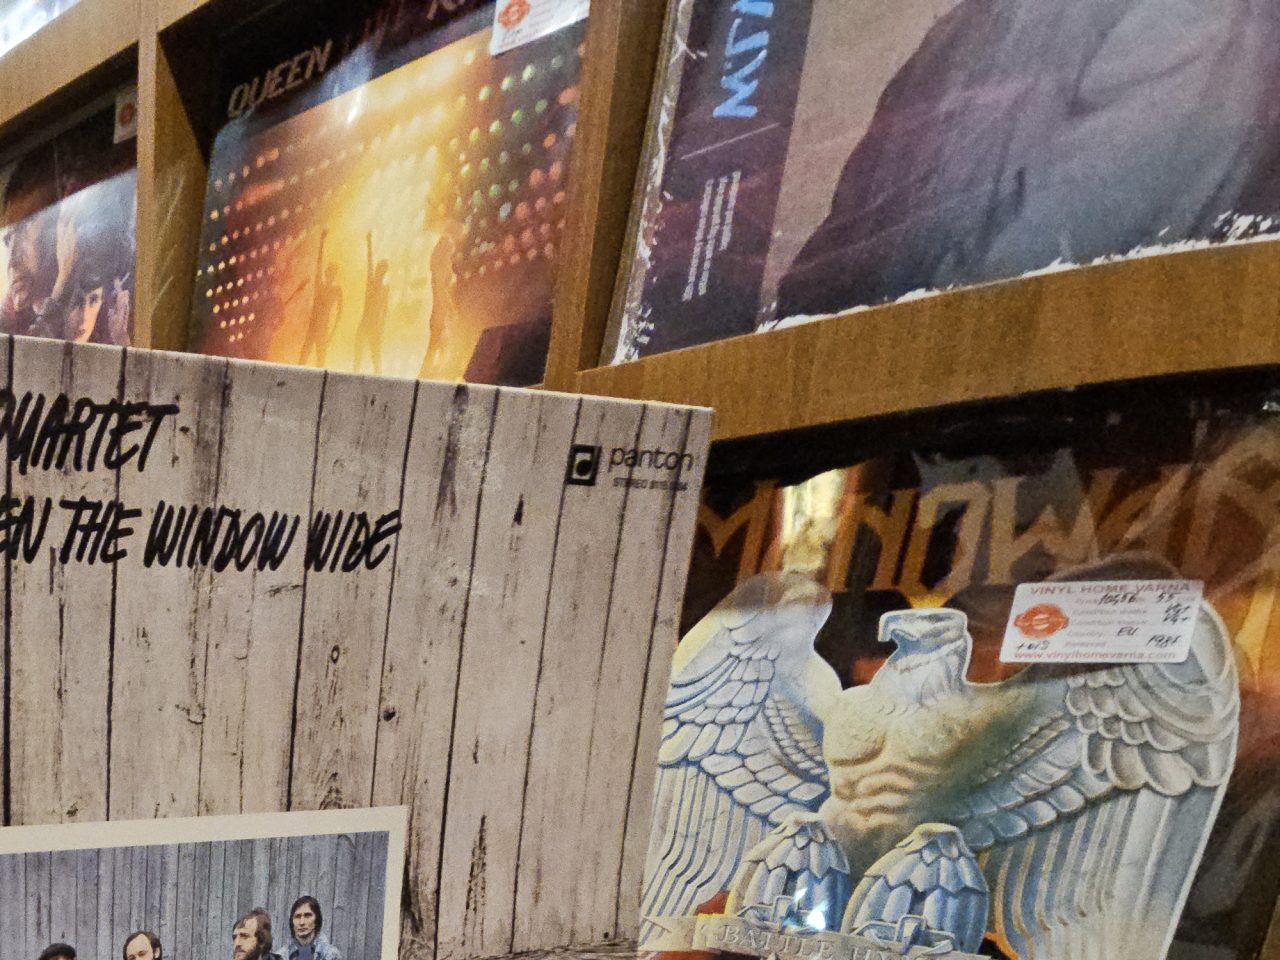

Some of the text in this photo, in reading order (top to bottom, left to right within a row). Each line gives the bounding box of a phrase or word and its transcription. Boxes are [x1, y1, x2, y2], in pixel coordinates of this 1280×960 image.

[227, 39, 332, 117] QUEEN
[608, 446, 694, 473] panton
[59, 499, 142, 564] THE
[143, 501, 301, 572] WINDOW
[306, 510, 402, 573] WIDE
[693, 458, 1280, 606] MNOWAR
[1029, 583, 1190, 594] VINYL HOME VARNA
